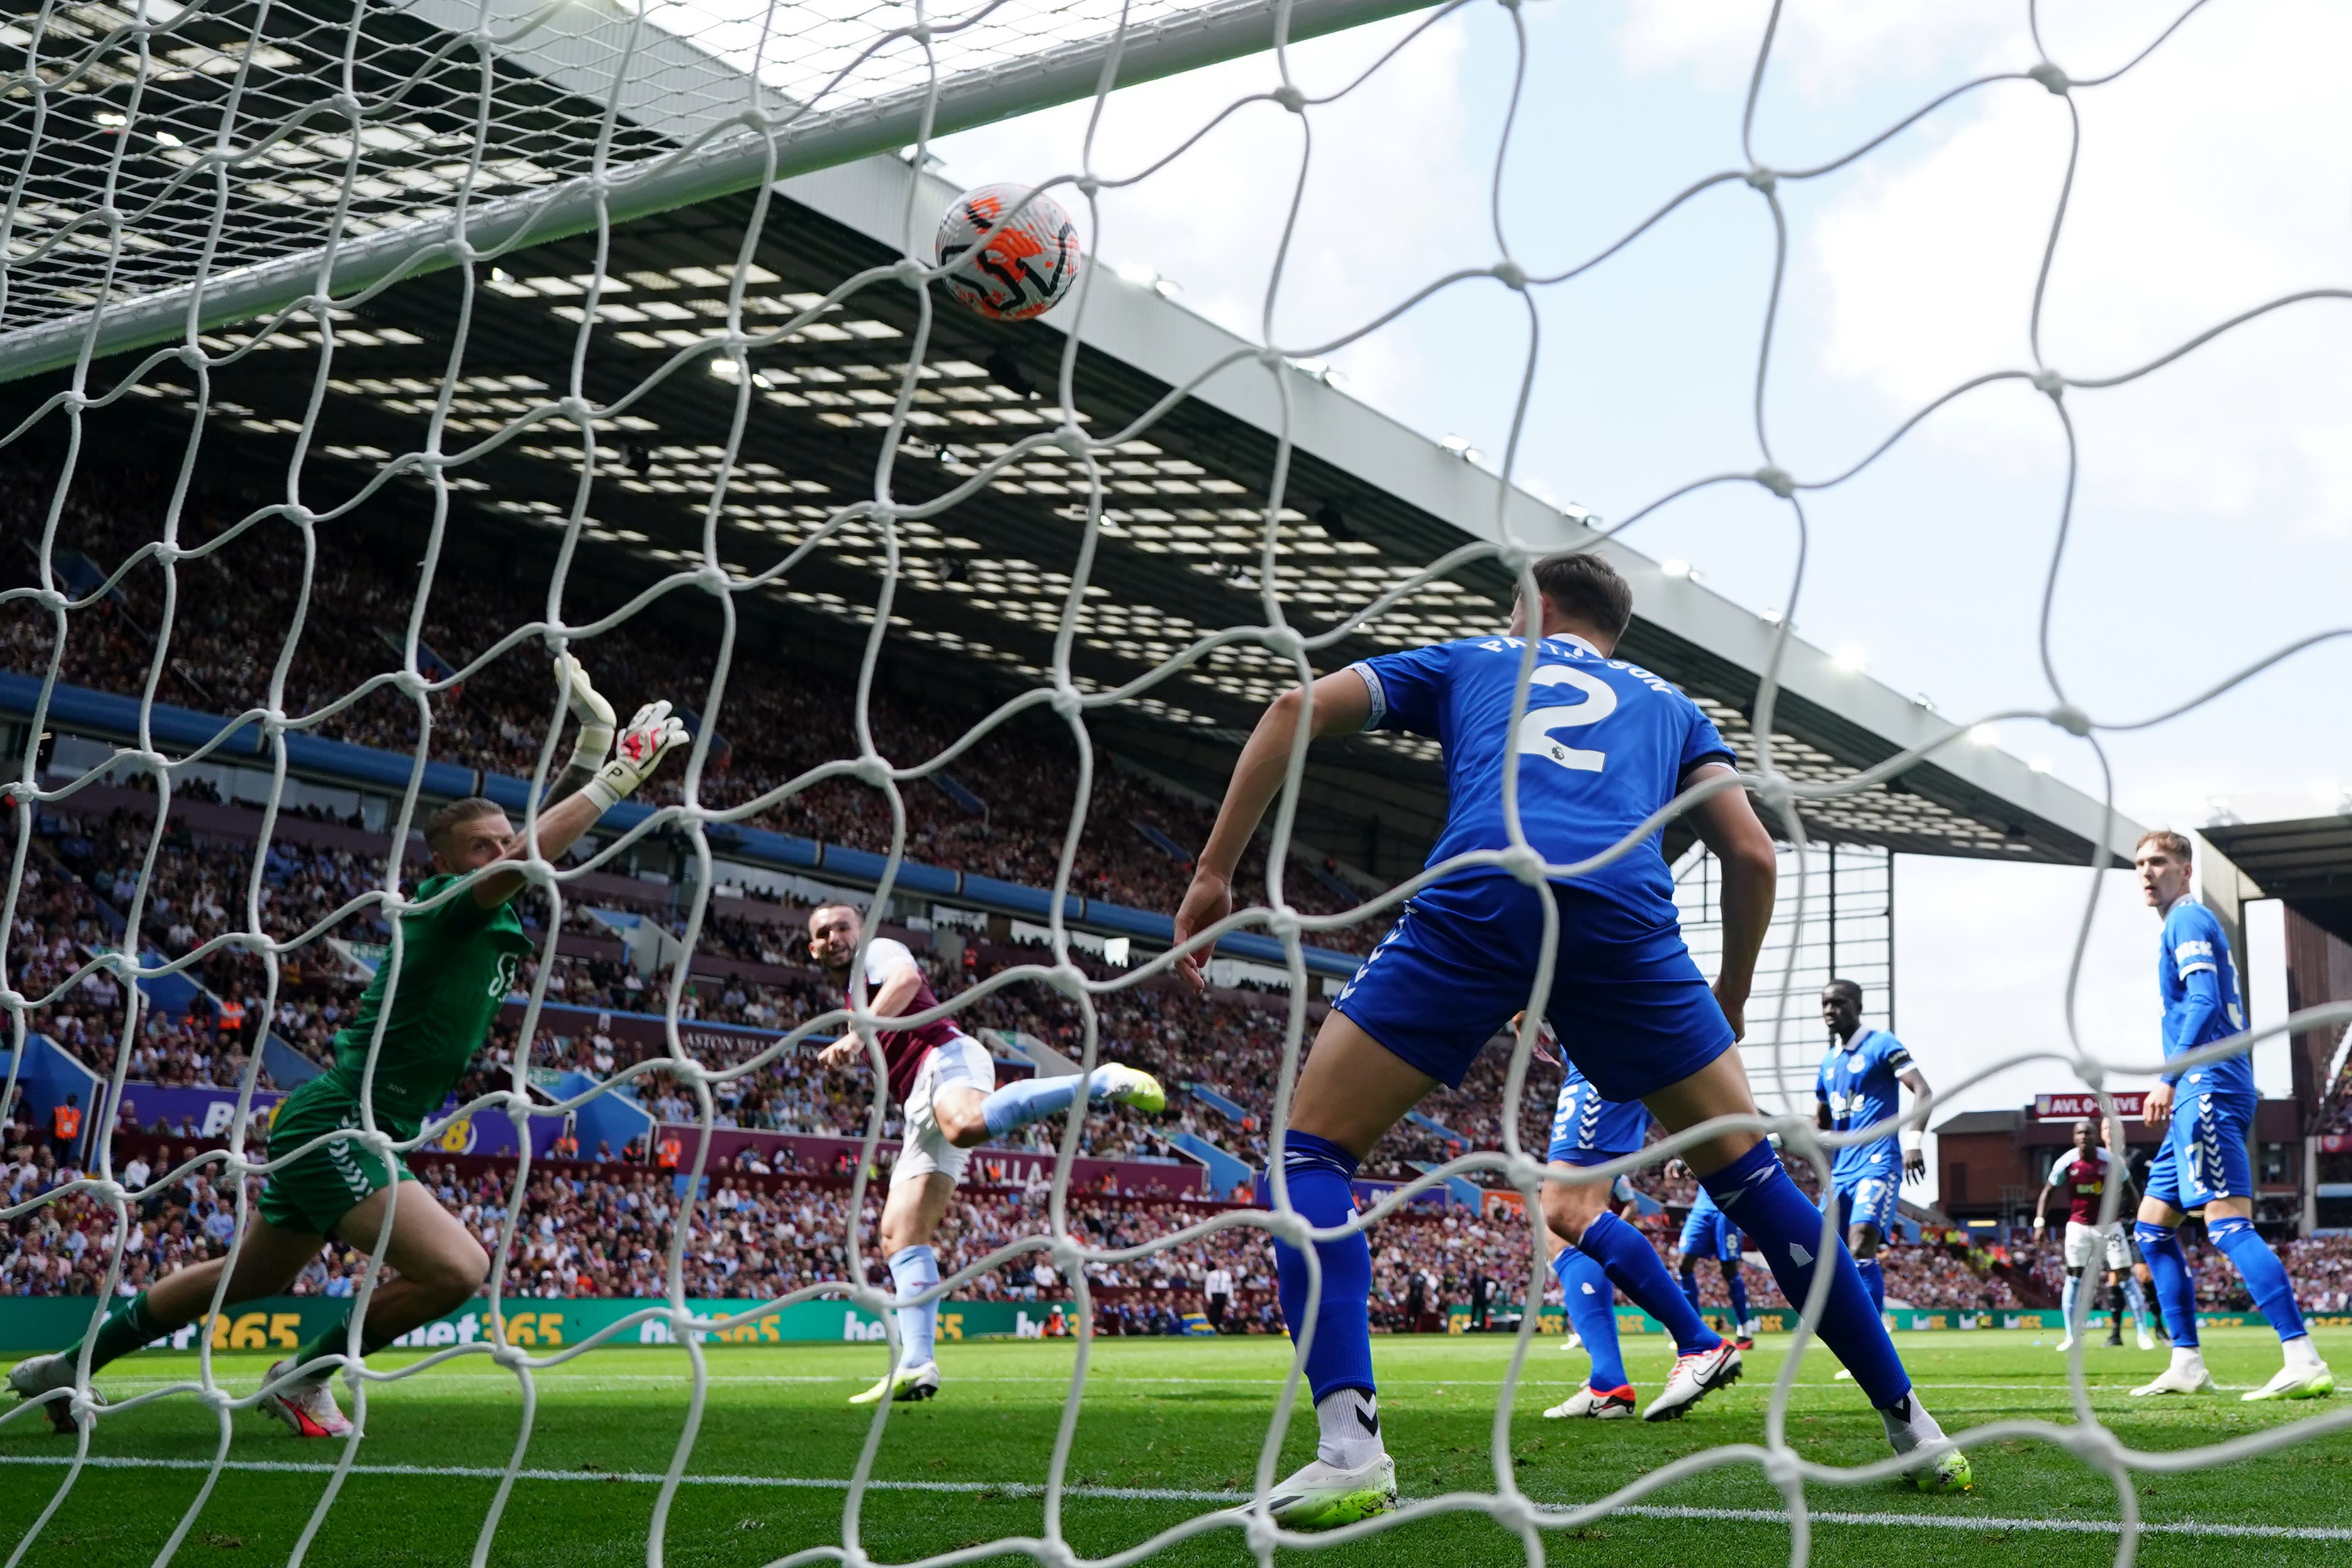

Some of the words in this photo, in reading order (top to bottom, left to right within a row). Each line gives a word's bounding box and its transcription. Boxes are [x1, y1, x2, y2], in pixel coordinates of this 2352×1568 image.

[1514, 664, 1618, 773] 2
[606, 766, 623, 778] P
[2052, 1099, 2081, 1114] AVL
[1855, 1179, 1887, 1205] 27
